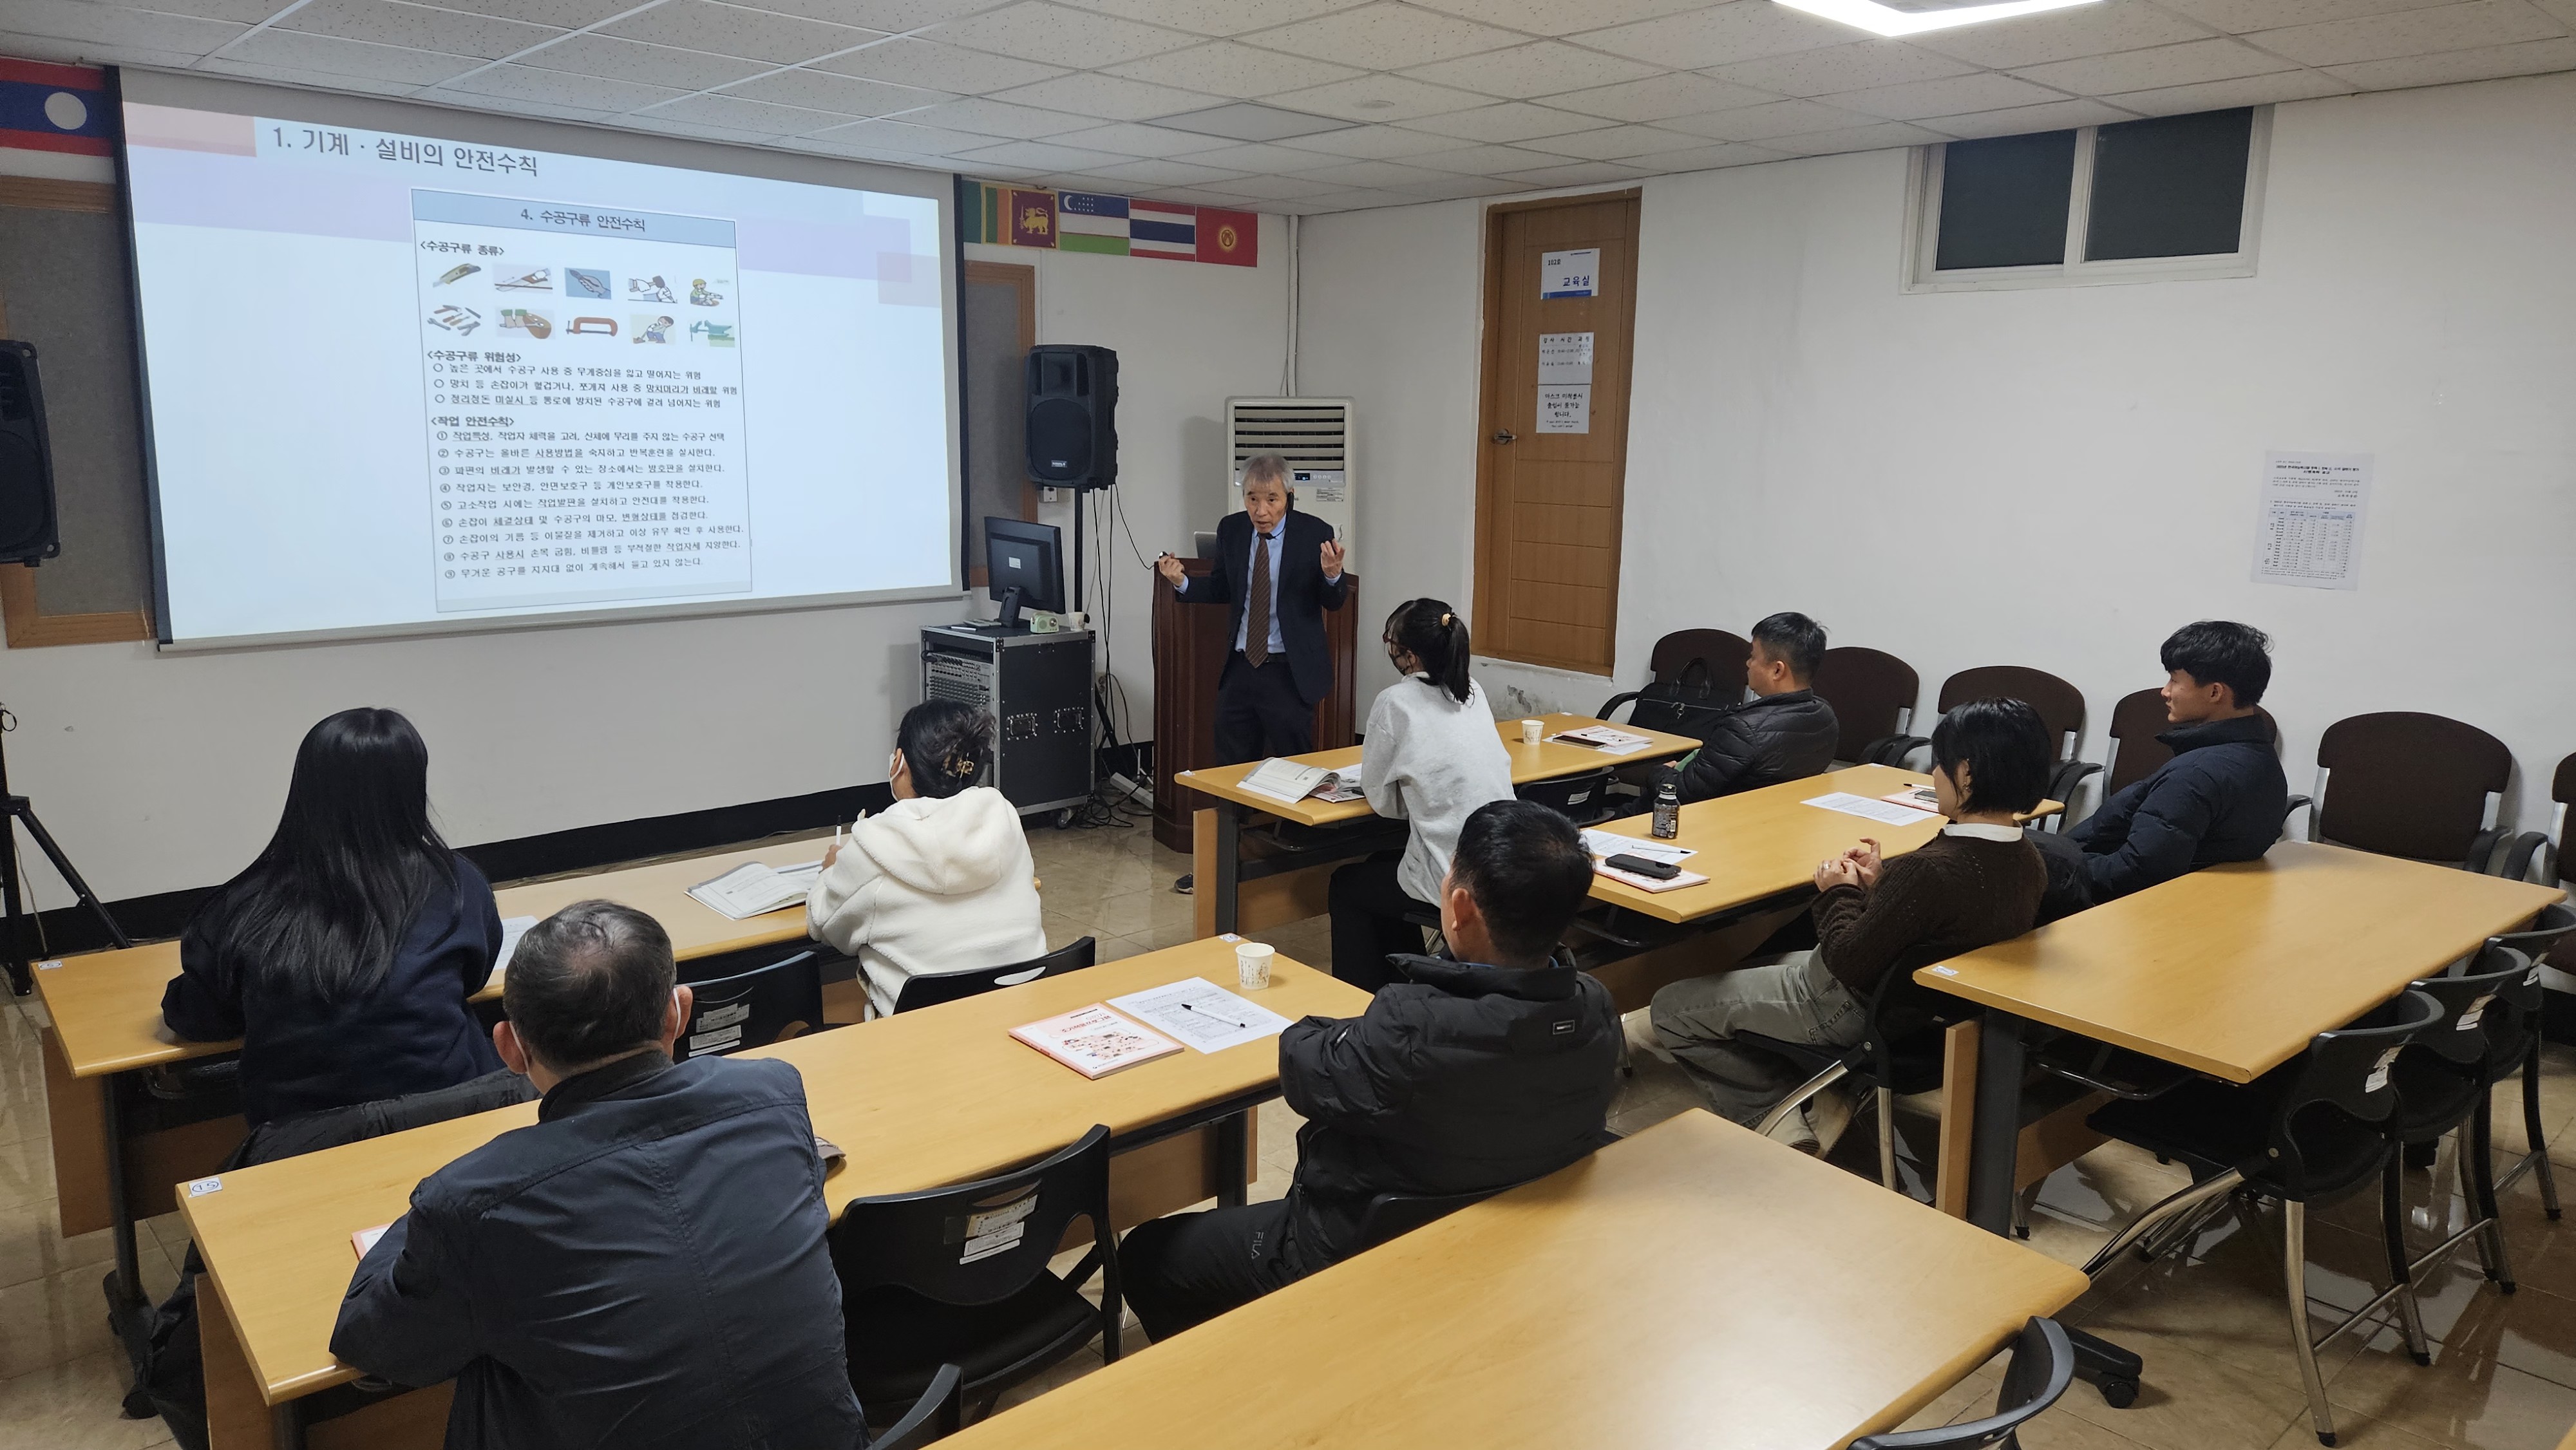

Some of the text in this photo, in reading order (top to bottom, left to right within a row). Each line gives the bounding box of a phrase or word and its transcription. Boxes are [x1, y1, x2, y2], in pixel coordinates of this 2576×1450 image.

[273, 127, 291, 147] 1.
[303, 130, 348, 156] 기계
[376, 138, 444, 166] 설비의
[454, 147, 538, 176] 안전수칙
[521, 209, 645, 232] 4. 수공구류 안전수칙
[420, 241, 504, 256] <수공구류 종류>
[1563, 275, 1589, 287] 교육실
[428, 350, 521, 362] <수공구류 위험성>
[450, 364, 701, 380] 높은 곳에서 수공구 사용 중 무게중심을 잃고 떨어지는 위험
[450, 379, 469, 388] 망치
[476, 380, 484, 388] 등
[491, 381, 527, 390] 손잡이가
[611, 383, 628, 391] 사용
[634, 384, 641, 392] 중
[647, 384, 688, 394] 망치머리가
[723, 386, 737, 395] 위험
[451, 395, 720, 408] 정리정돈 미실시 등 통로에 방치된 수공구에 걸려 넘어지는 위험
[431, 417, 514, 426] <작업 안전수칙>
[498, 431, 524, 440] 작업자
[529, 431, 555, 440] 체력을
[585, 432, 609, 440] 신체에
[663, 433, 679, 441] 않는
[709, 433, 724, 441] 선택
[455, 449, 494, 458] 수공구는
[501, 449, 529, 458] 올바른
[536, 449, 583, 458] 사용방법을
[589, 449, 625, 457] 숙지하고
[455, 466, 484, 475] 파편의
[527, 466, 554, 474] 발생할
[562, 466, 569, 474] 수
[576, 466, 592, 474] 있는
[598, 465, 643, 473] 장소에서는
[649, 464, 683, 473] 방호판을
[456, 483, 496, 492] 작업자는
[540, 482, 587, 491] 안면보호구
[594, 481, 601, 490] 등
[607, 481, 660, 489] 개인보호구를
[666, 480, 703, 489] 착용한다.
[457, 500, 497, 509] 고소작업
[504, 500, 533, 508] 시에는
[538, 498, 585, 507] 작업발판을
[591, 497, 627, 505] 설치하고
[632, 496, 667, 505] 안전대를
[459, 518, 487, 527] 손잡이
[493, 516, 533, 526] 체결상태
[540, 516, 547, 525] 및
[554, 514, 590, 523] 수공구의
[623, 513, 666, 522] 변형상태를
[672, 511, 708, 520] 점검한다.
[460, 534, 498, 543] 손잡이의
[506, 533, 524, 541] 기름
[531, 532, 539, 541] 등
[545, 531, 582, 540] 이물질을
[588, 529, 623, 538] 제거하고
[630, 528, 646, 536] 이상
[652, 527, 668, 536] 유무
[674, 527, 690, 535] 확인
[708, 525, 743, 534] 사용한다.
[460, 551, 489, 561] 수공구
[496, 550, 524, 560] 사용시
[531, 549, 548, 557] 손목
[614, 545, 621, 554] 등
[628, 543, 661, 552] 부적절한
[667, 542, 699, 551] 작업자세
[705, 540, 740, 549] 지양한다.
[461, 569, 490, 578] 무거운
[497, 567, 526, 576] 공구를
[532, 565, 560, 573] 지지대
[590, 562, 624, 570] 계속해서
[1251, 1231, 1264, 1259] FILA
